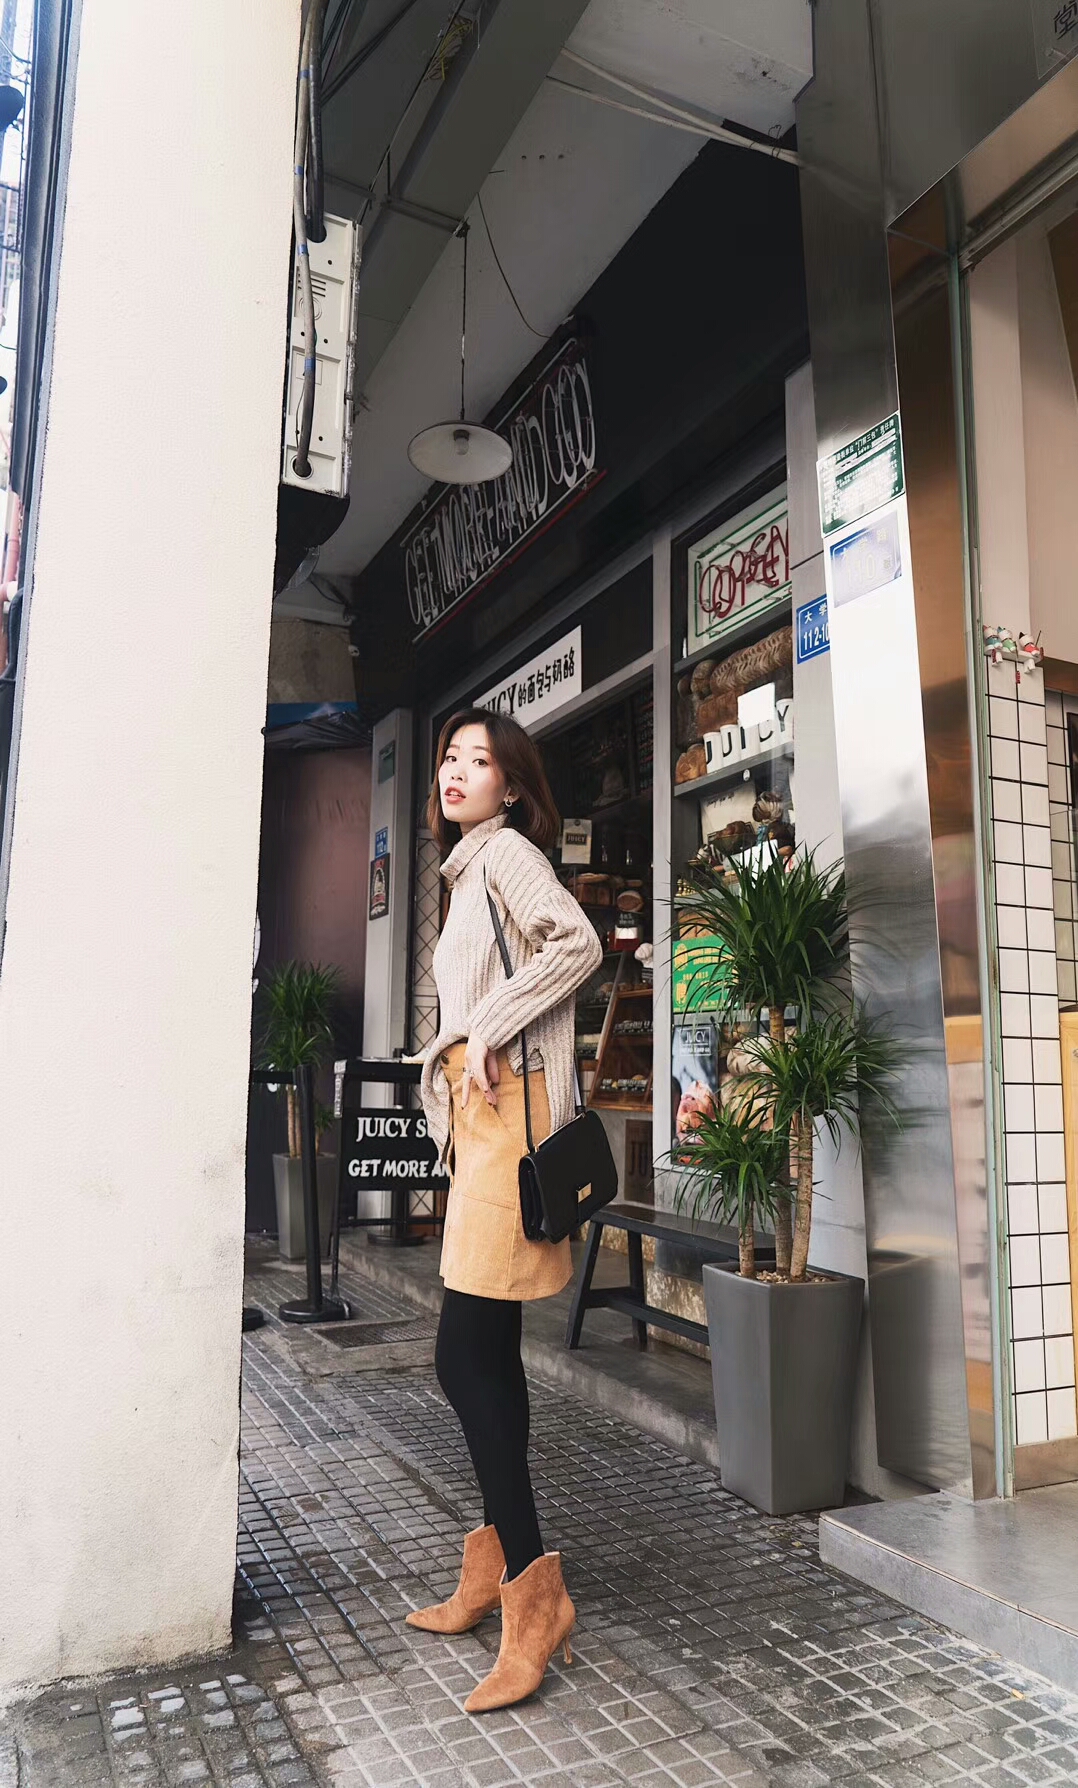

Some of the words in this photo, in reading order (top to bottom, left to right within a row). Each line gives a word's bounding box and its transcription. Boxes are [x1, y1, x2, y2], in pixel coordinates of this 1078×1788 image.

[356, 1117, 411, 1142] JUICY
[347, 1158, 381, 1178] GET
[382, 1159, 429, 1178] MORE
